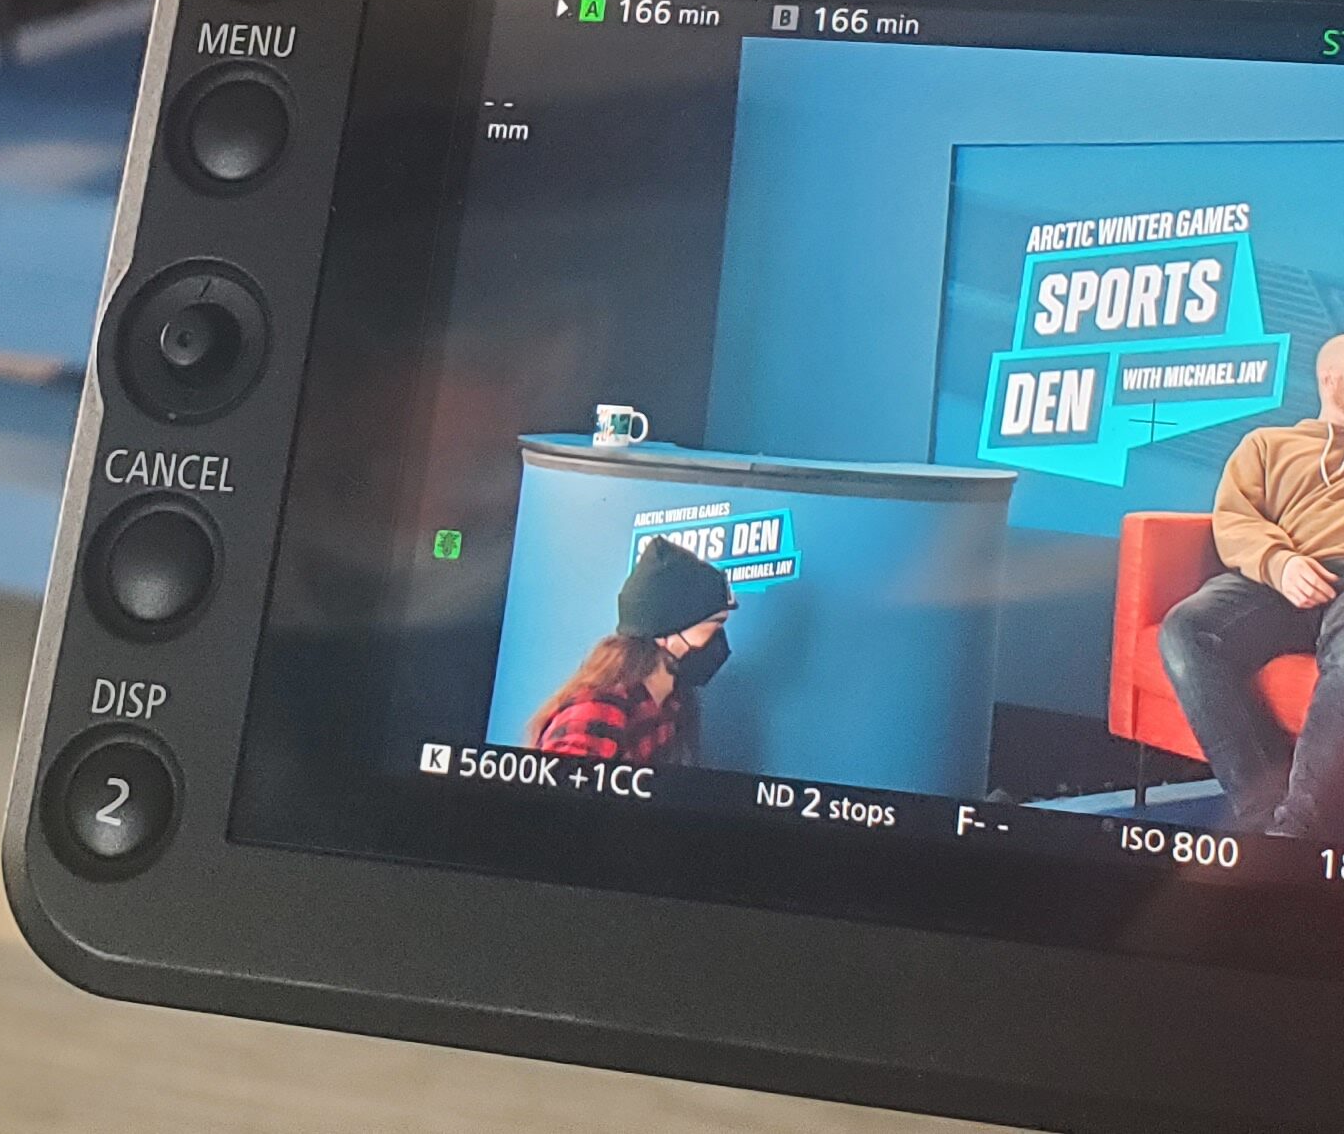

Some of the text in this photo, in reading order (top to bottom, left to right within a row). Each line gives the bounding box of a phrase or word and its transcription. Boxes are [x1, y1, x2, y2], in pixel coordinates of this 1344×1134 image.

[678, 4, 720, 27] min
[814, 7, 869, 35] 166
[876, 14, 920, 36] min
[197, 23, 296, 58] MENU
[487, 121, 530, 141] mm
[1026, 203, 1250, 253] ARCTIC WINTER GAMES
[1033, 258, 1222, 337] SPORTS
[1122, 360, 1269, 390] WITH MICHAEL JAY
[1000, 368, 1096, 437] DEN
[105, 449, 235, 493] CANCEL
[634, 501, 731, 527] ARCTIC WINTER GAMES
[731, 518, 780, 556] DEN
[732, 563, 775, 582] MICHAEL
[776, 560, 794, 576] JAY
[91, 678, 167, 719] DISP
[459, 748, 559, 787] 5600K
[568, 763, 654, 800] +1CC
[95, 777, 130, 826] 2
[756, 781, 897, 827] ND 2 stops
[1121, 825, 1240, 868] ISO 800
